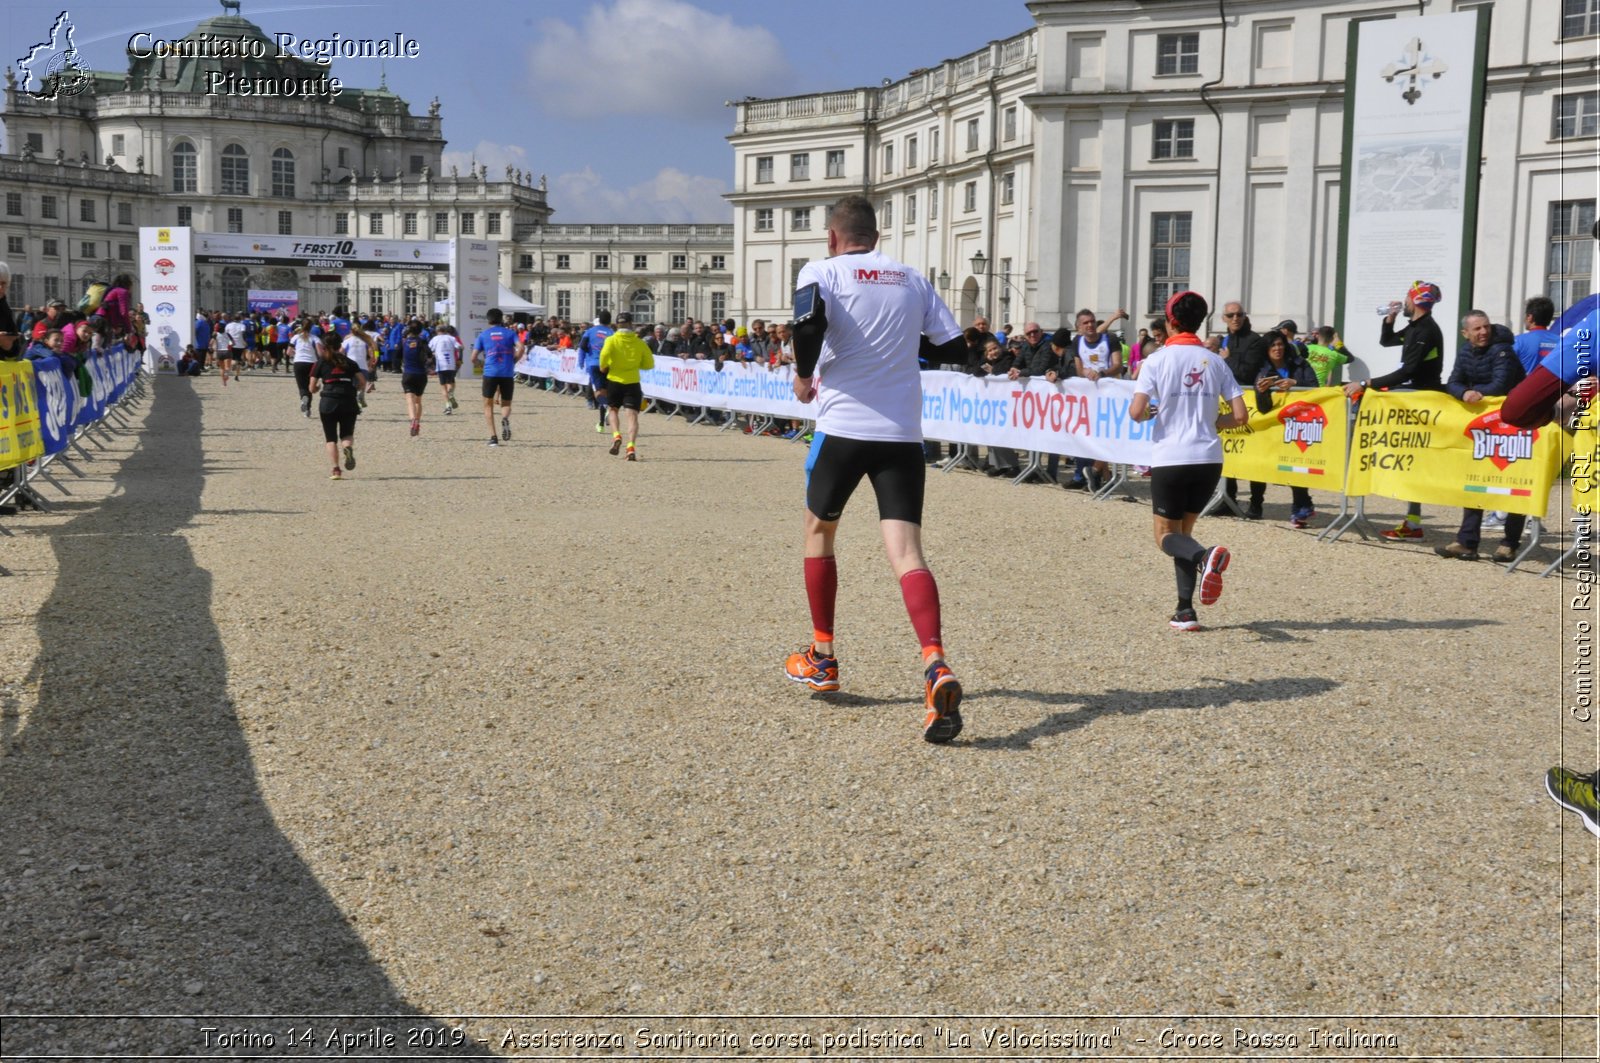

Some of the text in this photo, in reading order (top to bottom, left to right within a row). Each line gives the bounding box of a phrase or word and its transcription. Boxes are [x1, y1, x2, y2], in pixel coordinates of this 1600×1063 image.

[307, 260, 344, 268] ARRIVO
[151, 284, 178, 292] GIMAX
[672, 367, 698, 392] TOYOTA
[698, 370, 727, 395] HYBRID
[727, 372, 759, 396] Central
[760, 374, 794, 402] Motors
[922, 387, 947, 421] tral
[949, 387, 1008, 427] Motors
[1011, 390, 1091, 436] TOYOTA
[1387, 408, 1431, 426] PRESO
[1283, 416, 1324, 447] Biraghi
[1223, 438, 1245, 454] CK?
[1470, 428, 1532, 463] Biraghi
[1482, 475, 1503, 484] LATTE
